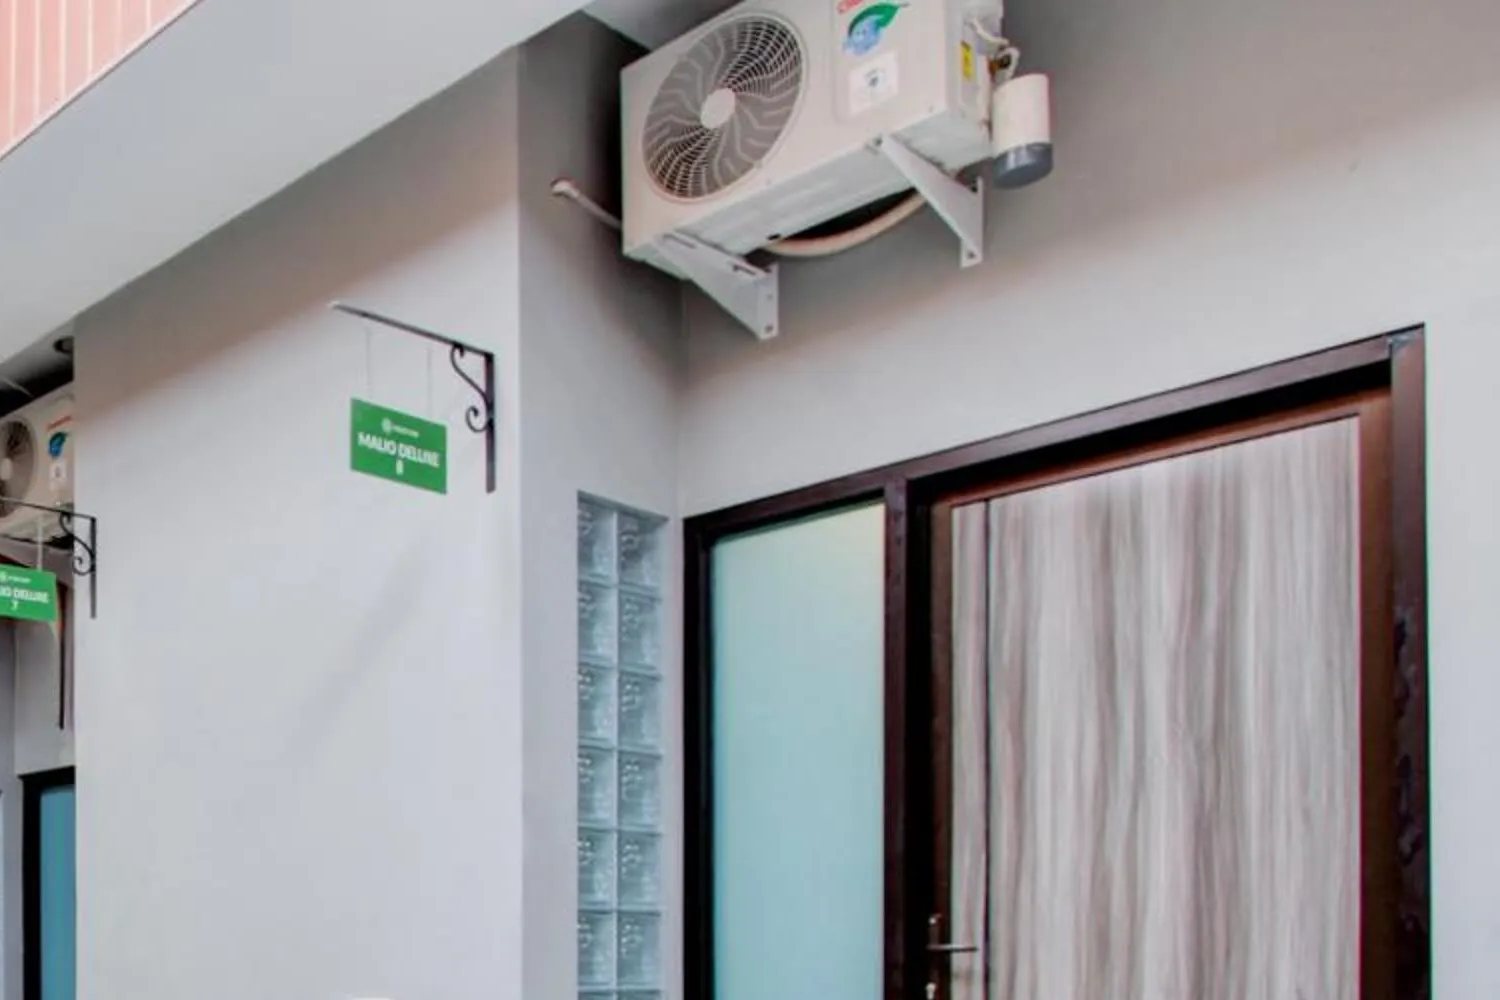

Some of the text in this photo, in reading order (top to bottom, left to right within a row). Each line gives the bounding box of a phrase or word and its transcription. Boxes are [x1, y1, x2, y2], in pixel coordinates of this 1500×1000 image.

[357, 432, 439, 468] MALIO DELUXE
[13, 588, 49, 604] DELUXE
